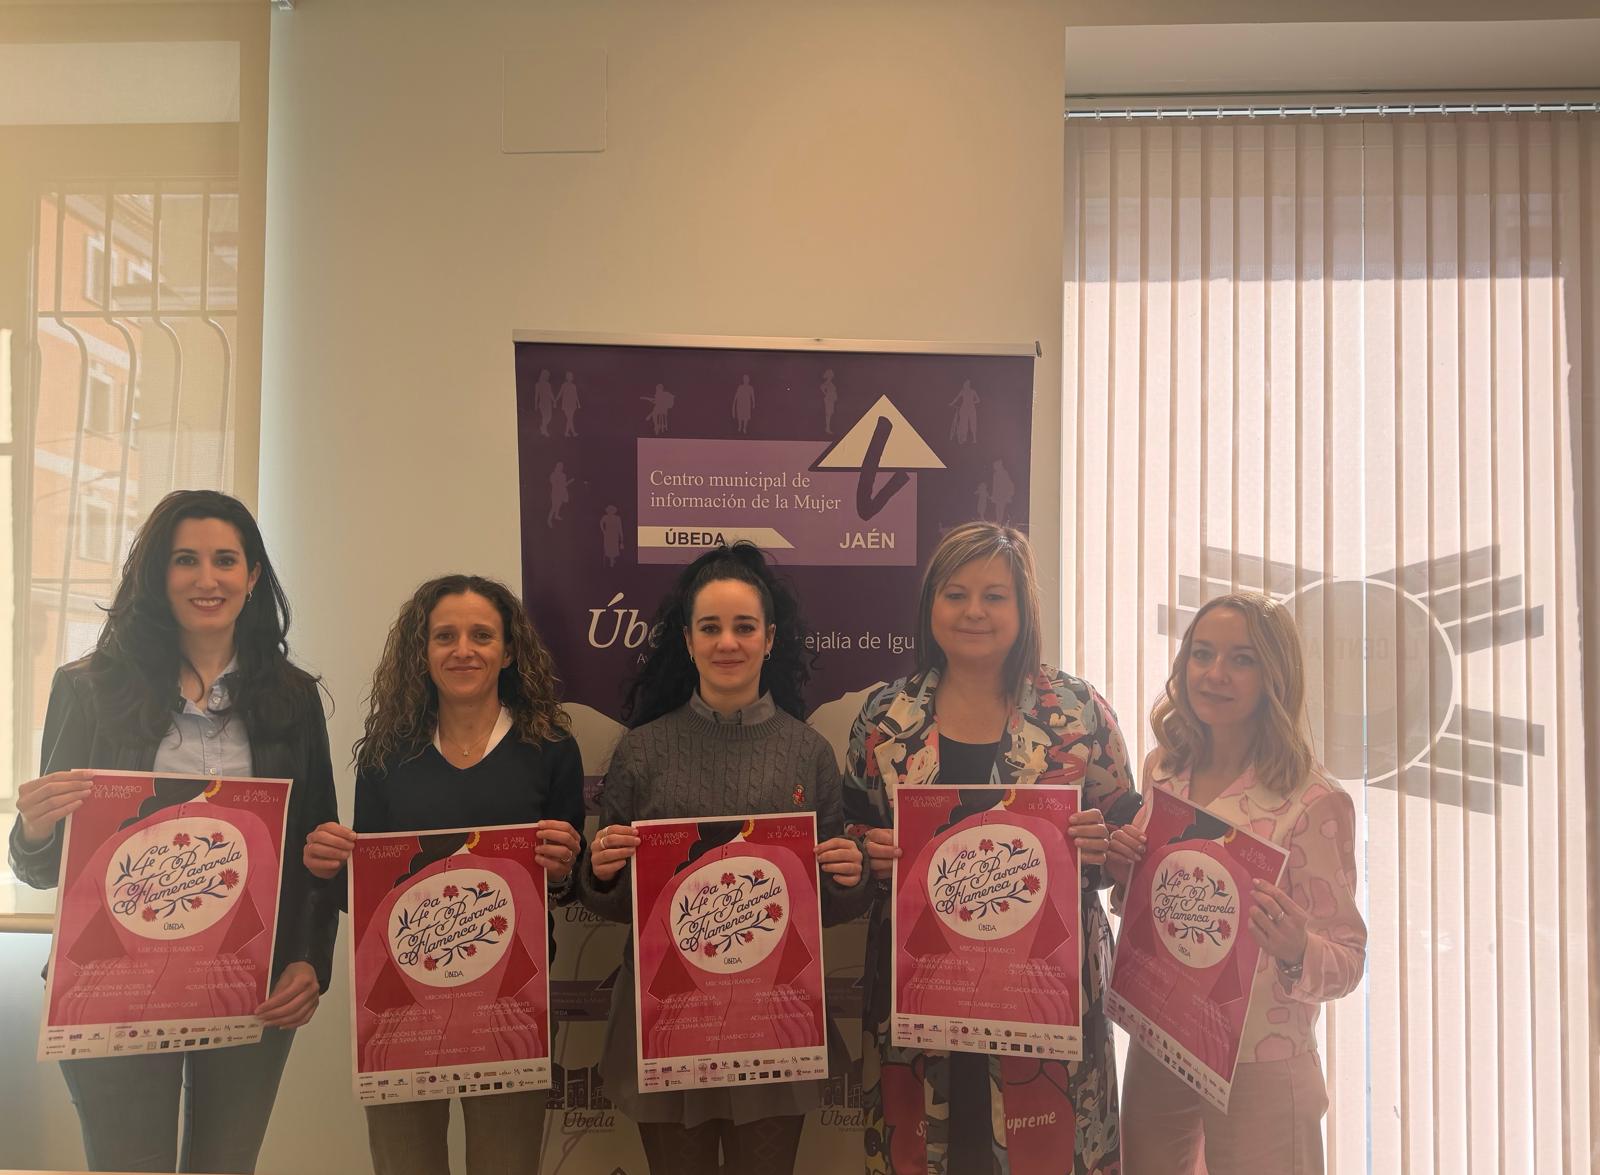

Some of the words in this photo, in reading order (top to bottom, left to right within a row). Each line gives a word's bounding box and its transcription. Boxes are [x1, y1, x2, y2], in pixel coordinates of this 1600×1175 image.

[650, 470, 704, 487] Centro
[709, 471, 787, 491] municipal
[792, 472, 811, 488] de
[650, 492, 746, 508] información
[751, 493, 770, 509] de
[775, 494, 789, 509] la
[794, 494, 842, 513] Mujer
[665, 528, 726, 546] ÚBEDA
[839, 528, 895, 549] JAÉN
[588, 592, 665, 649] Úbe
[804, 631, 851, 652] ejalía
[858, 632, 881, 649] de
[888, 632, 915, 654] Igu
[159, 842, 242, 887] Pasarela
[970, 848, 1040, 889] Pasarela
[113, 871, 206, 915] Flamenca
[434, 890, 508, 937] Pasarela
[713, 877, 782, 922] Pasarela
[935, 874, 1011, 915] Flamenca
[397, 921, 477, 965] Flamenca
[678, 907, 755, 952] Flamenca
[563, 1106, 616, 1128] Úbeda
[1004, 1111, 1057, 1136] upreme
